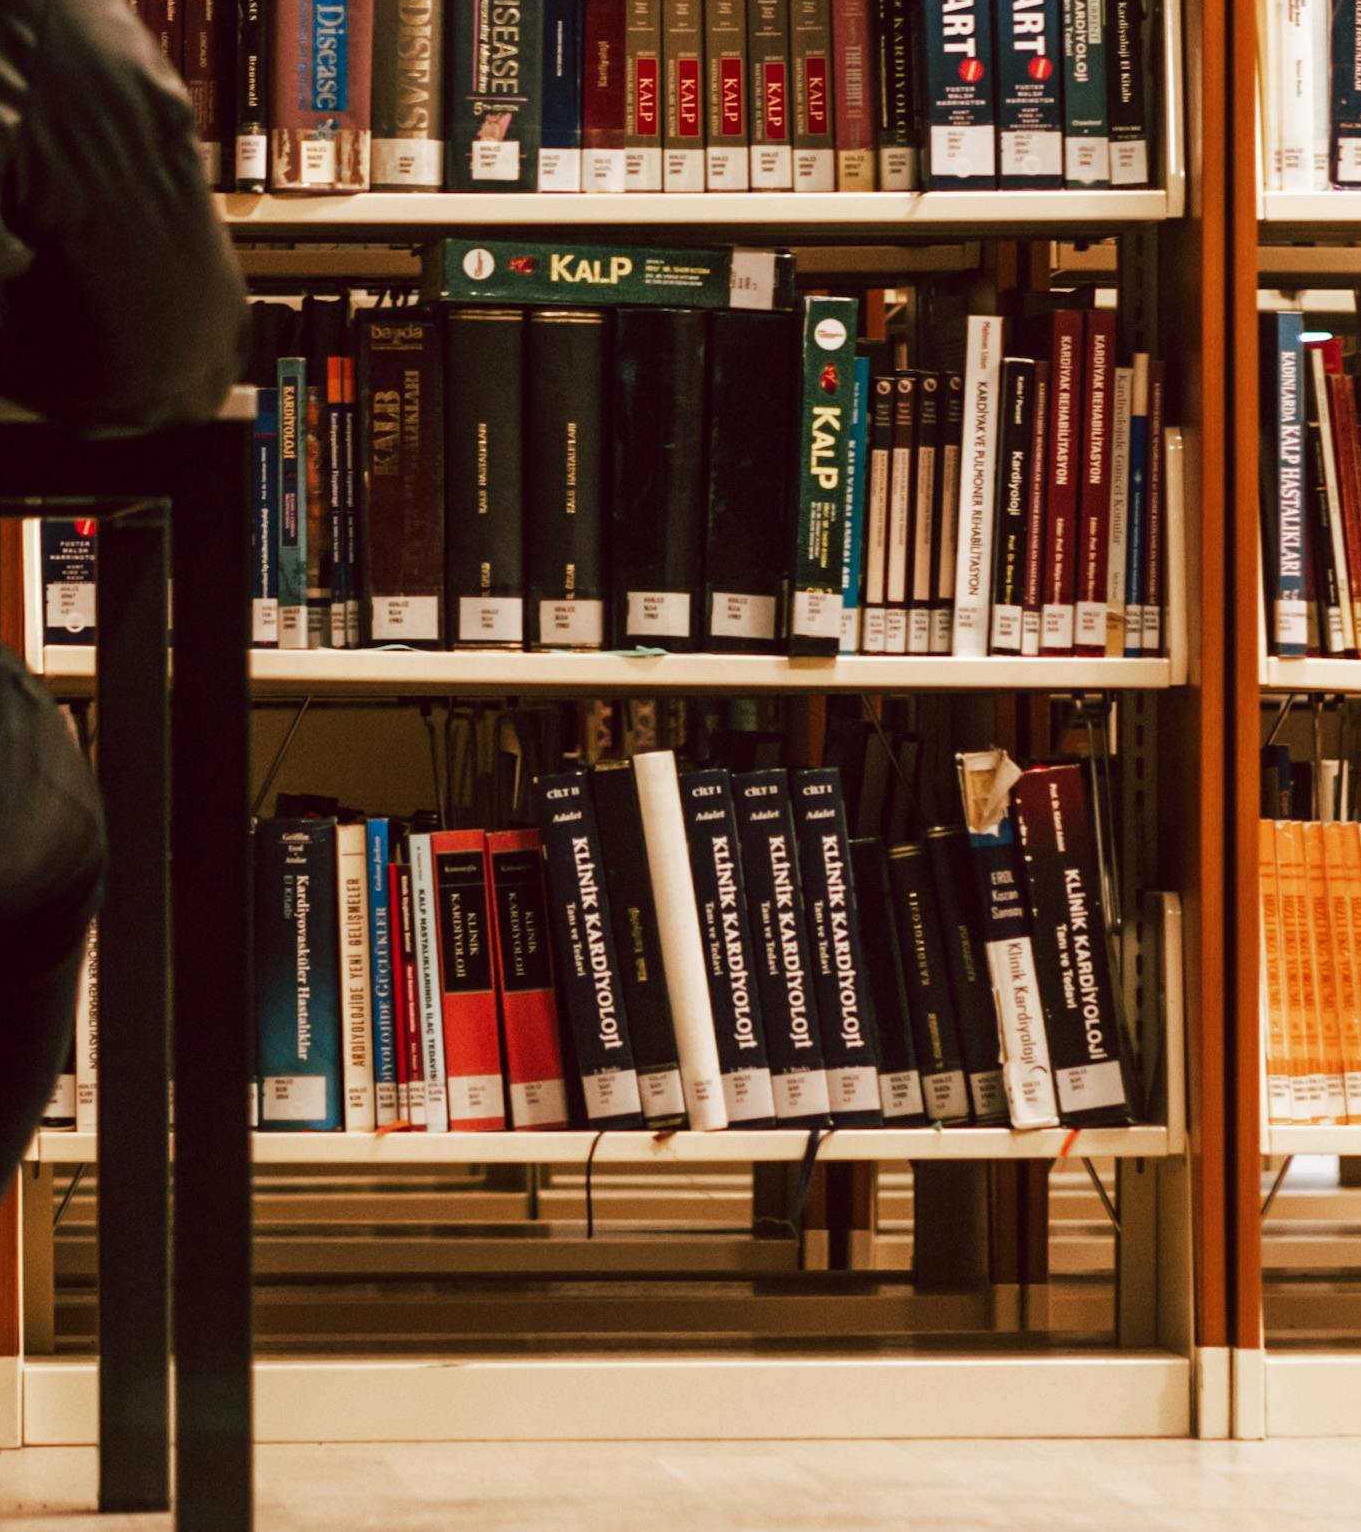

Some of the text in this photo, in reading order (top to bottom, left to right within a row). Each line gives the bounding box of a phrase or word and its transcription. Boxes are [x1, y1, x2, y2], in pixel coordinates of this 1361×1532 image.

[314, 4, 344, 109] Disease
[639, 77, 654, 121] KALP
[681, 78, 696, 123] KALP
[723, 78, 738, 122] KALP
[809, 76, 824, 121] KALP
[767, 82, 782, 127] KALP
[549, 253, 633, 284] KALP
[809, 405, 842, 490] KALP
[1006, 451, 1023, 516] Kardiyoloji
[1280, 350, 1301, 577] KADINLARDA KALP HASTALIKLARI
[294, 875, 310, 1061] Kardiyovasküler Hastalıklar
[571, 836, 624, 1050] KLİNİK KARDİYOLOJİ
[712, 836, 759, 1049] KLİNİK KARDİYOLOJİ
[768, 835, 814, 1049] KLİNİK KARDİYOLOJİ
[821, 834, 865, 1049] KLİNİK KARDİYOLOJİ
[1063, 868, 1108, 1059] KLİNİK KARDİYOLOJİ
